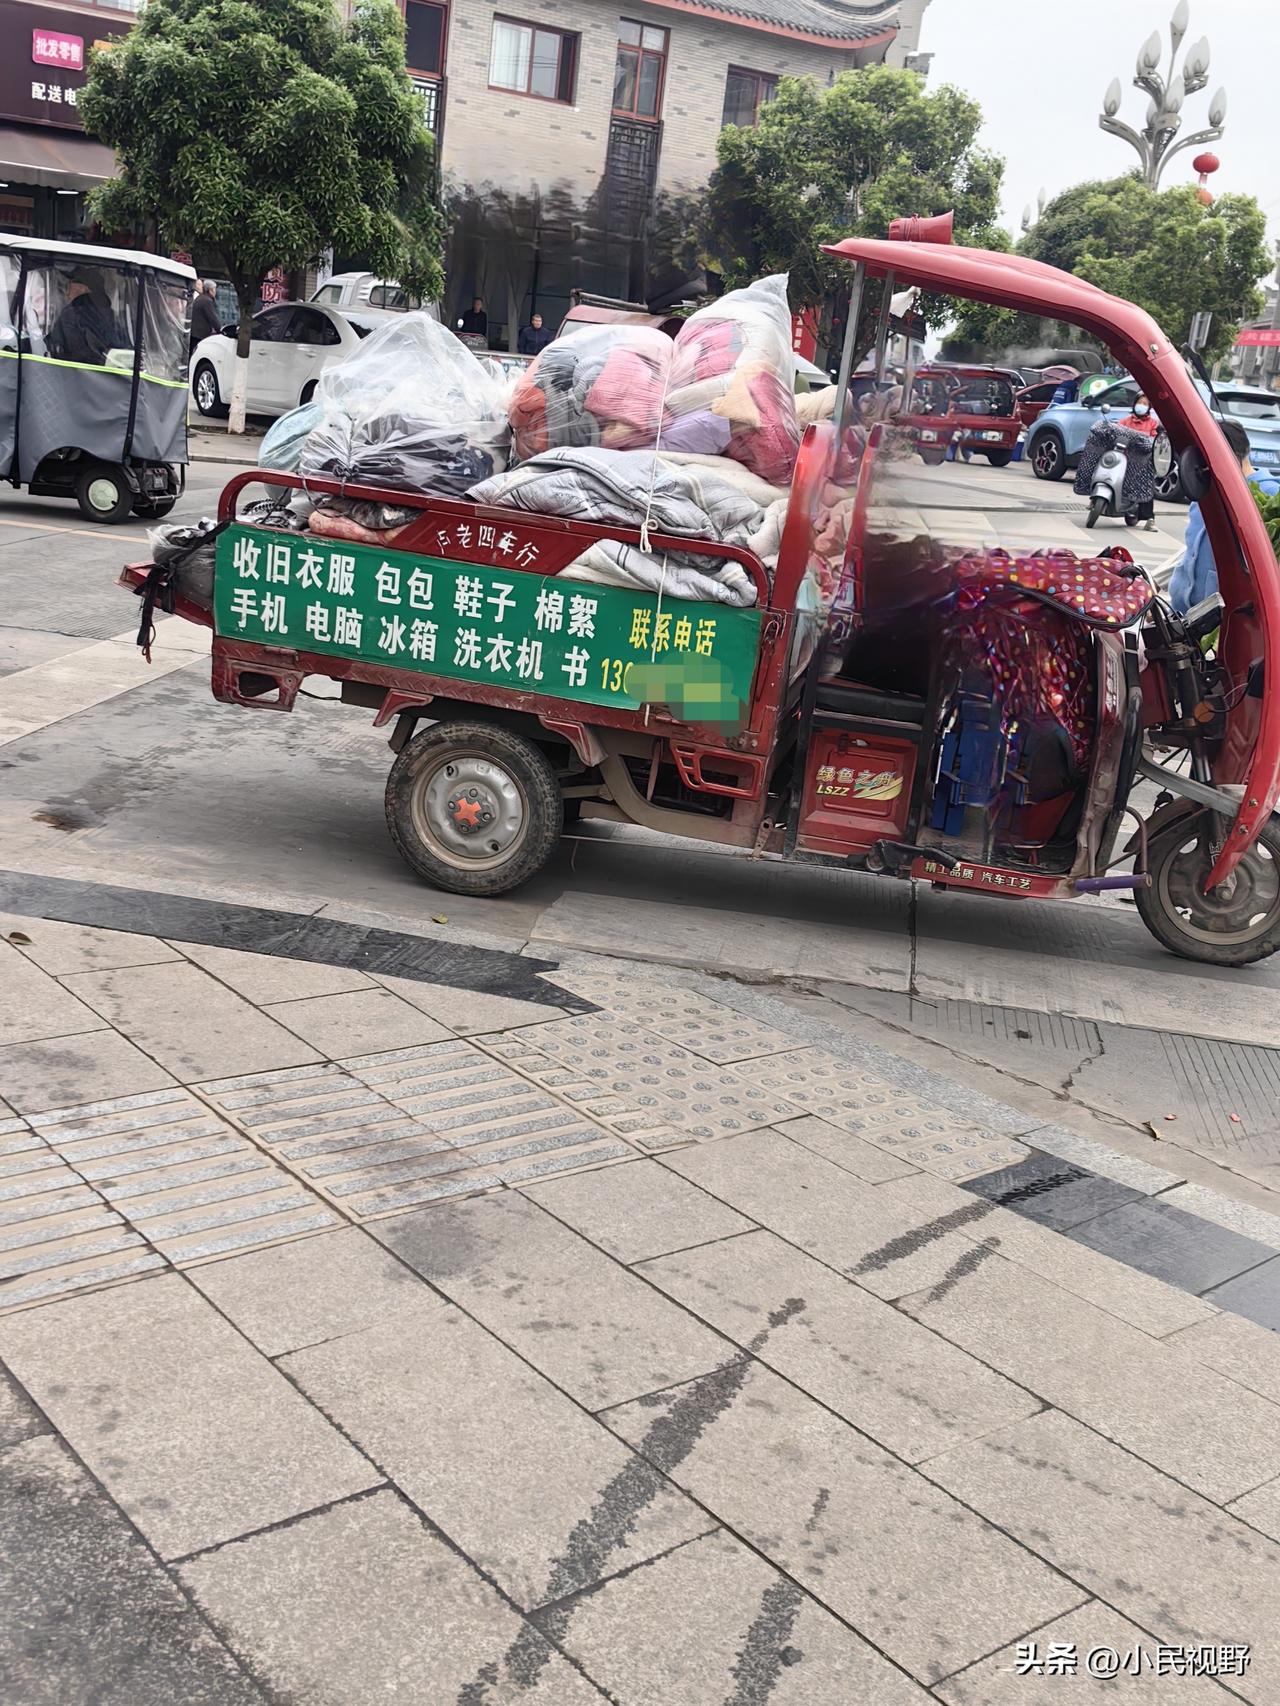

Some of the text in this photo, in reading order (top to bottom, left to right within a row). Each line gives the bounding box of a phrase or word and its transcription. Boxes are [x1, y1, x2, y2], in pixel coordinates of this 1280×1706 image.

[35, 36, 81, 62] 批发零售
[31, 81, 78, 106] 配送电
[232, 537, 598, 639] 收旧衣服 包包 鞋子 棉絮
[230, 588, 590, 687] 手机 电脑 冰箱 洗衣机 书
[629, 608, 716, 657] 联系电话
[816, 784, 850, 796] LSZZ
[981, 871, 1032, 890] 汽车工艺
